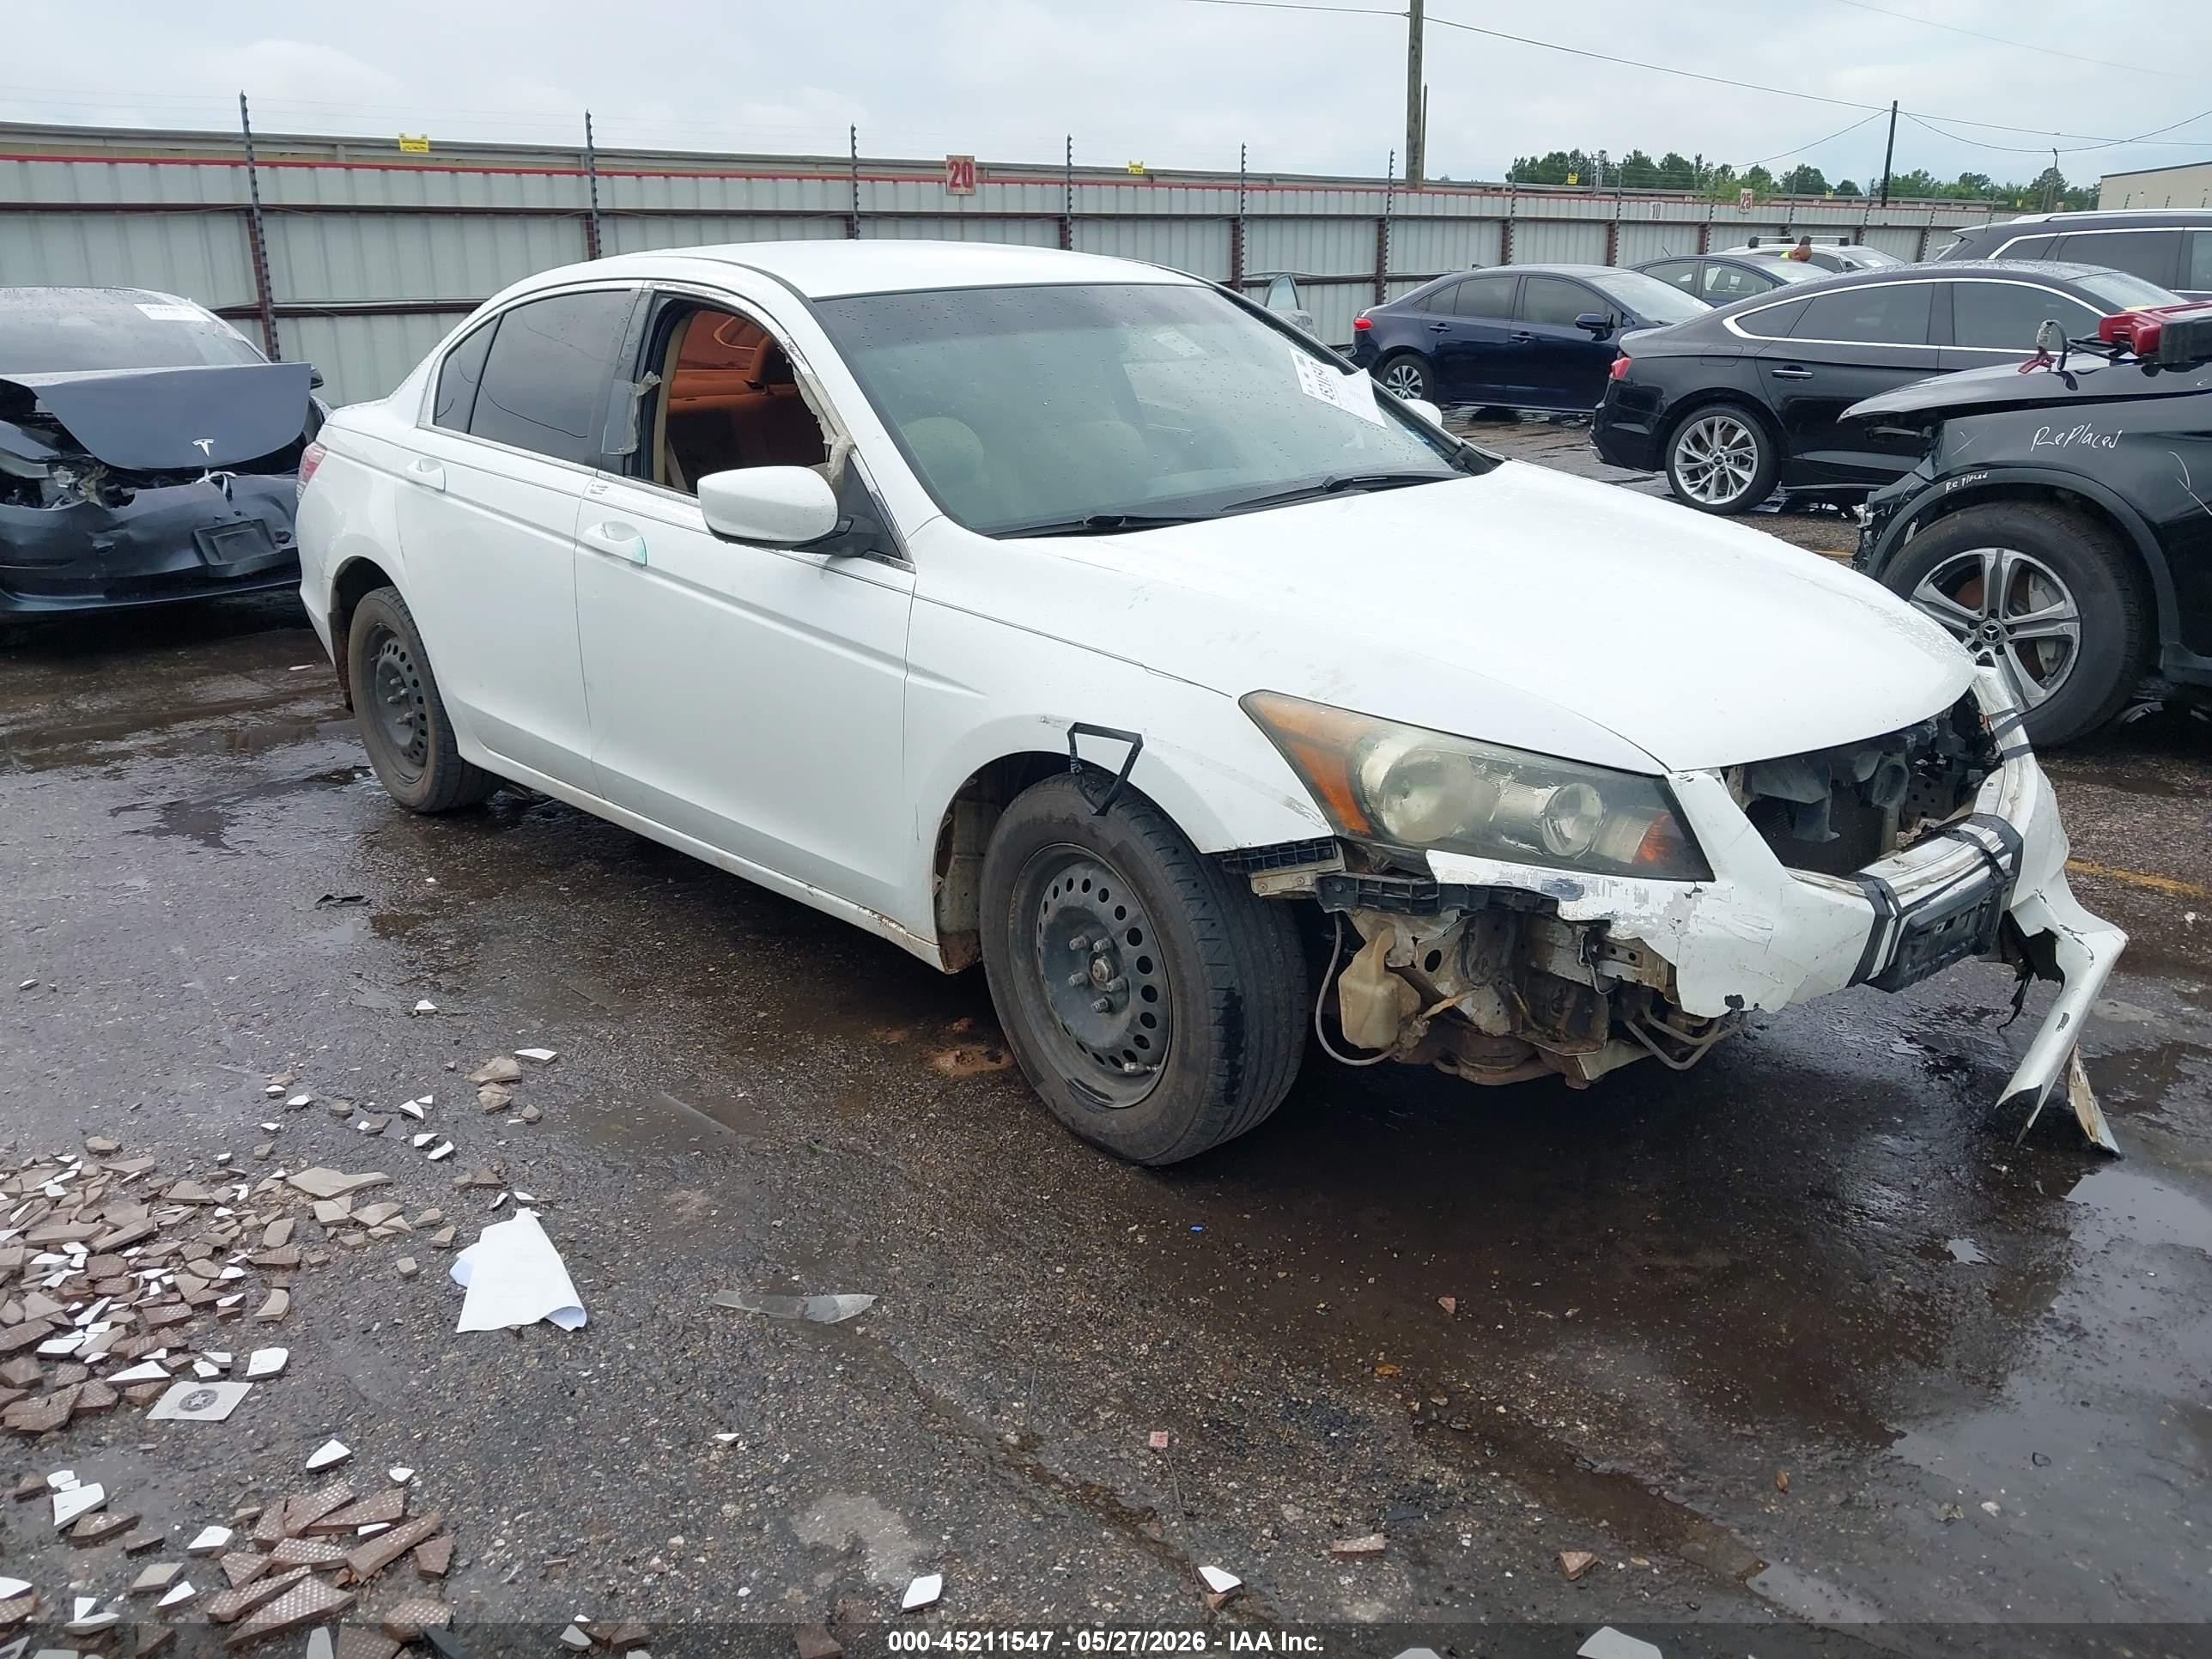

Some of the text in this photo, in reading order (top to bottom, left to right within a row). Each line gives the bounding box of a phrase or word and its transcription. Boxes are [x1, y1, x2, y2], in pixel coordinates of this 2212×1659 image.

[948, 161, 973, 188] 20
[1741, 191, 1752, 210] 25
[1652, 203, 1662, 220] 10
